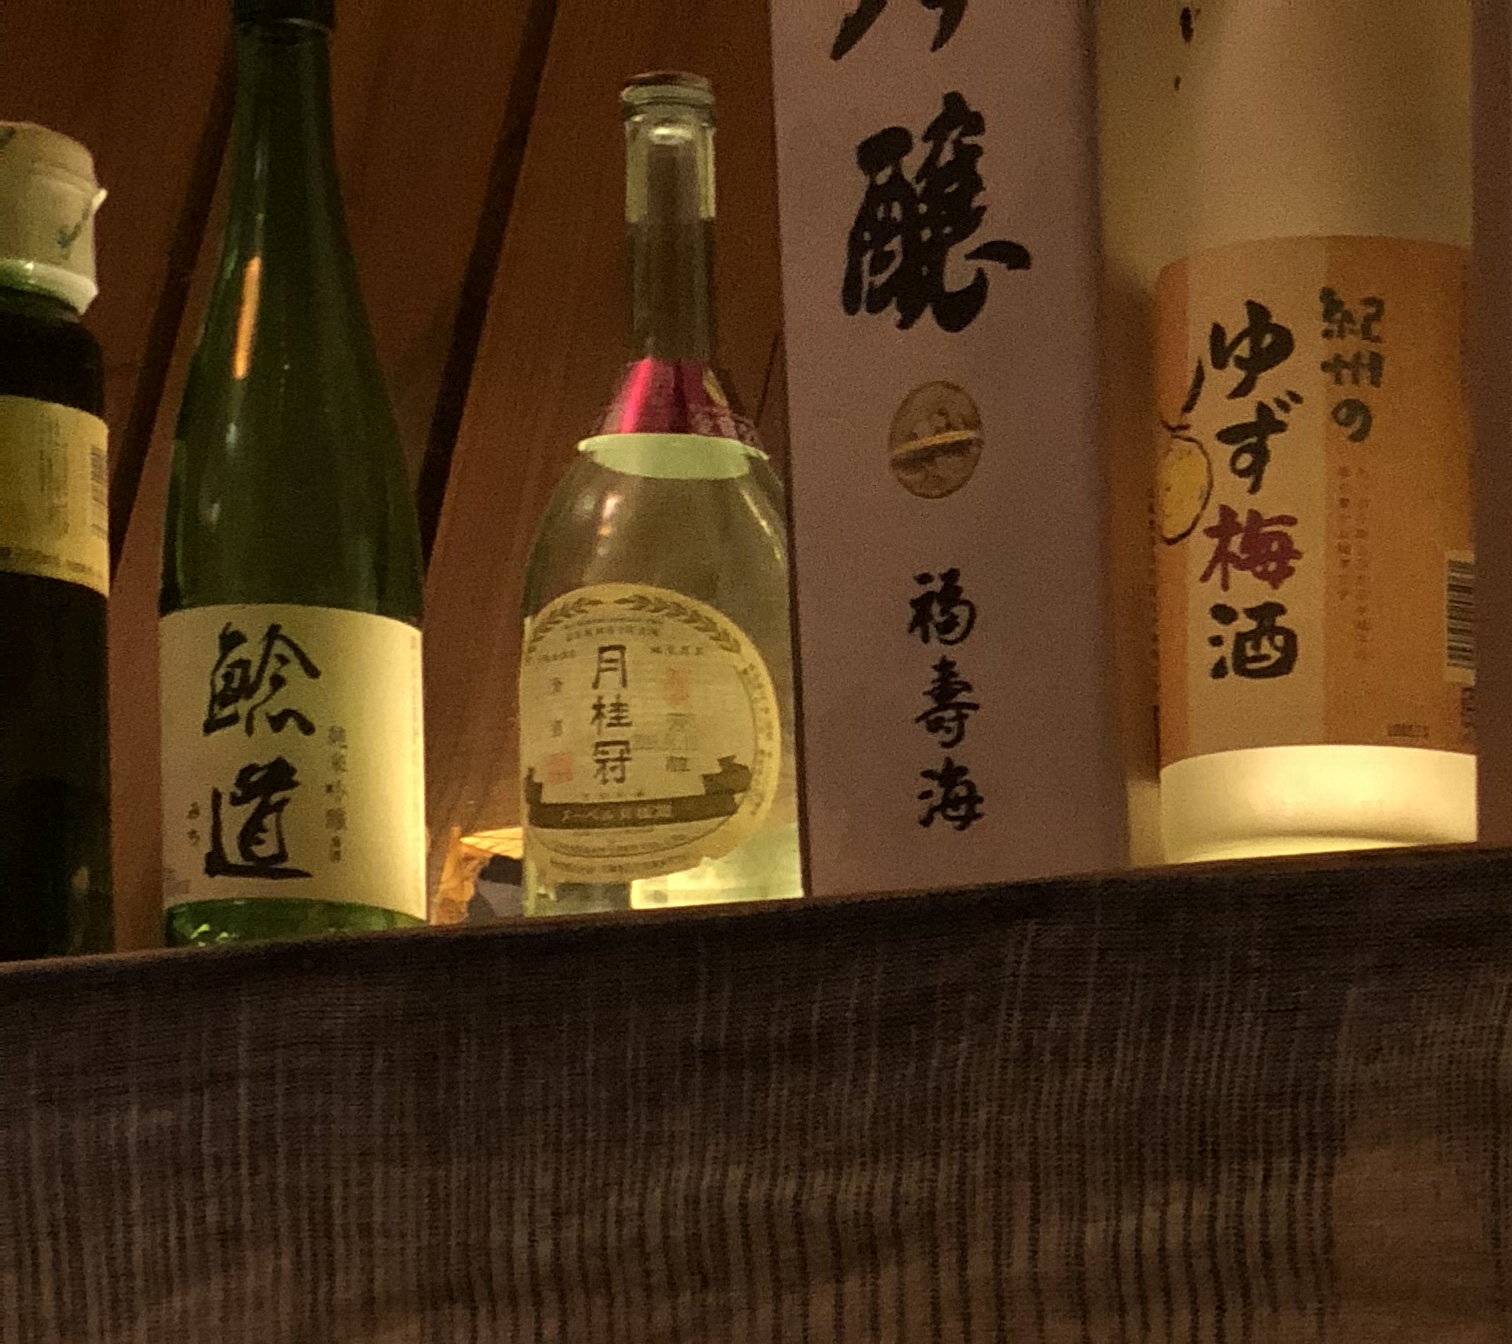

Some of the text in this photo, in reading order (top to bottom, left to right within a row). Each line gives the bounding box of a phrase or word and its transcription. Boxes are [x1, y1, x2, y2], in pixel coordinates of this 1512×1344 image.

[1318, 286, 1386, 443] 紀州の
[590, 643, 633, 785] 月桂冠
